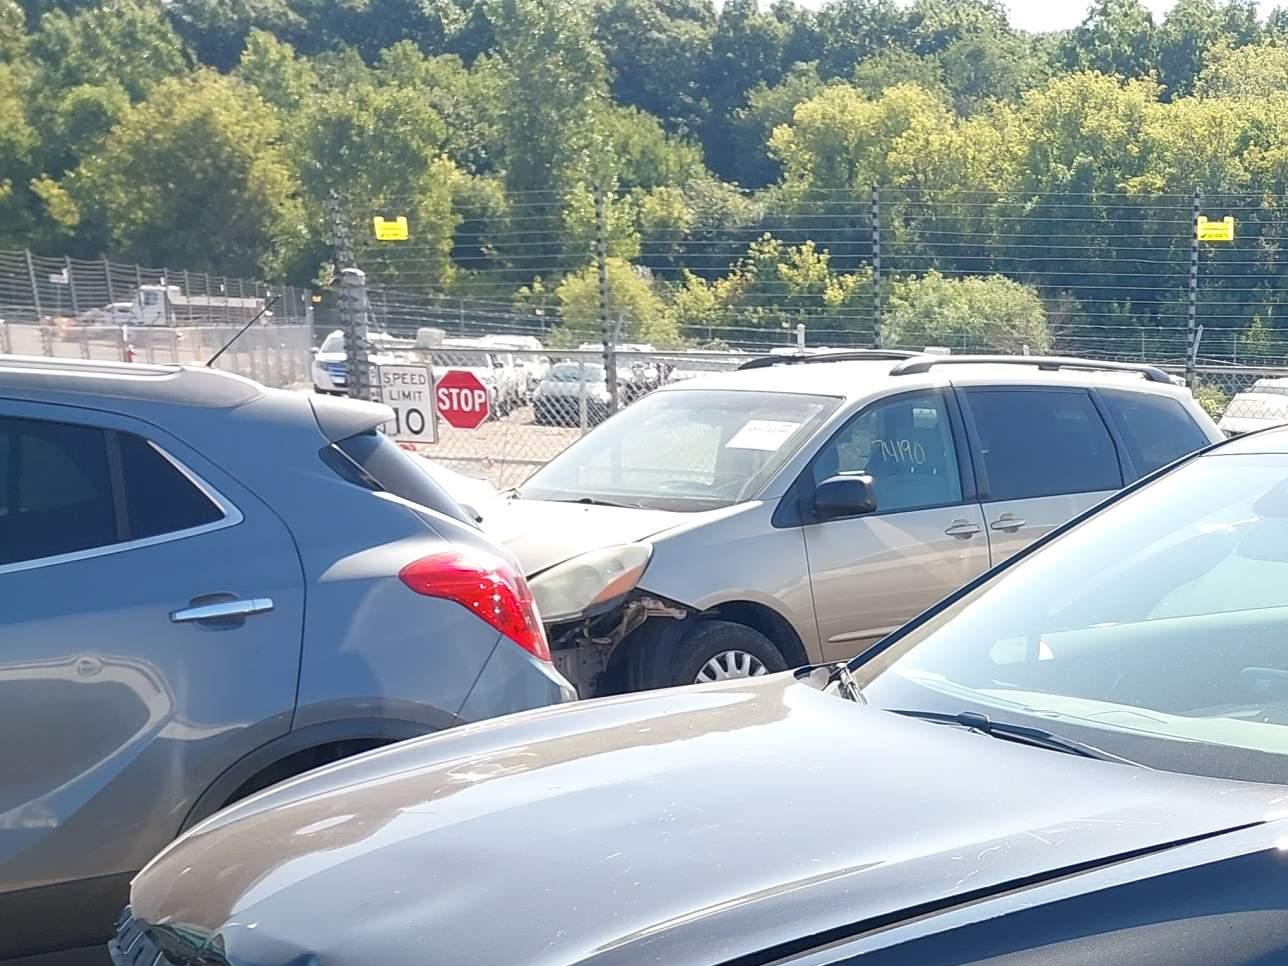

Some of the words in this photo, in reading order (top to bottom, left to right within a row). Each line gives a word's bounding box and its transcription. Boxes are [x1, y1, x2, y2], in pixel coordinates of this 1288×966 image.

[383, 372, 426, 385] SPEED
[388, 390, 423, 401] LIMIT
[438, 387, 486, 412] STOP
[393, 407, 425, 435] 10
